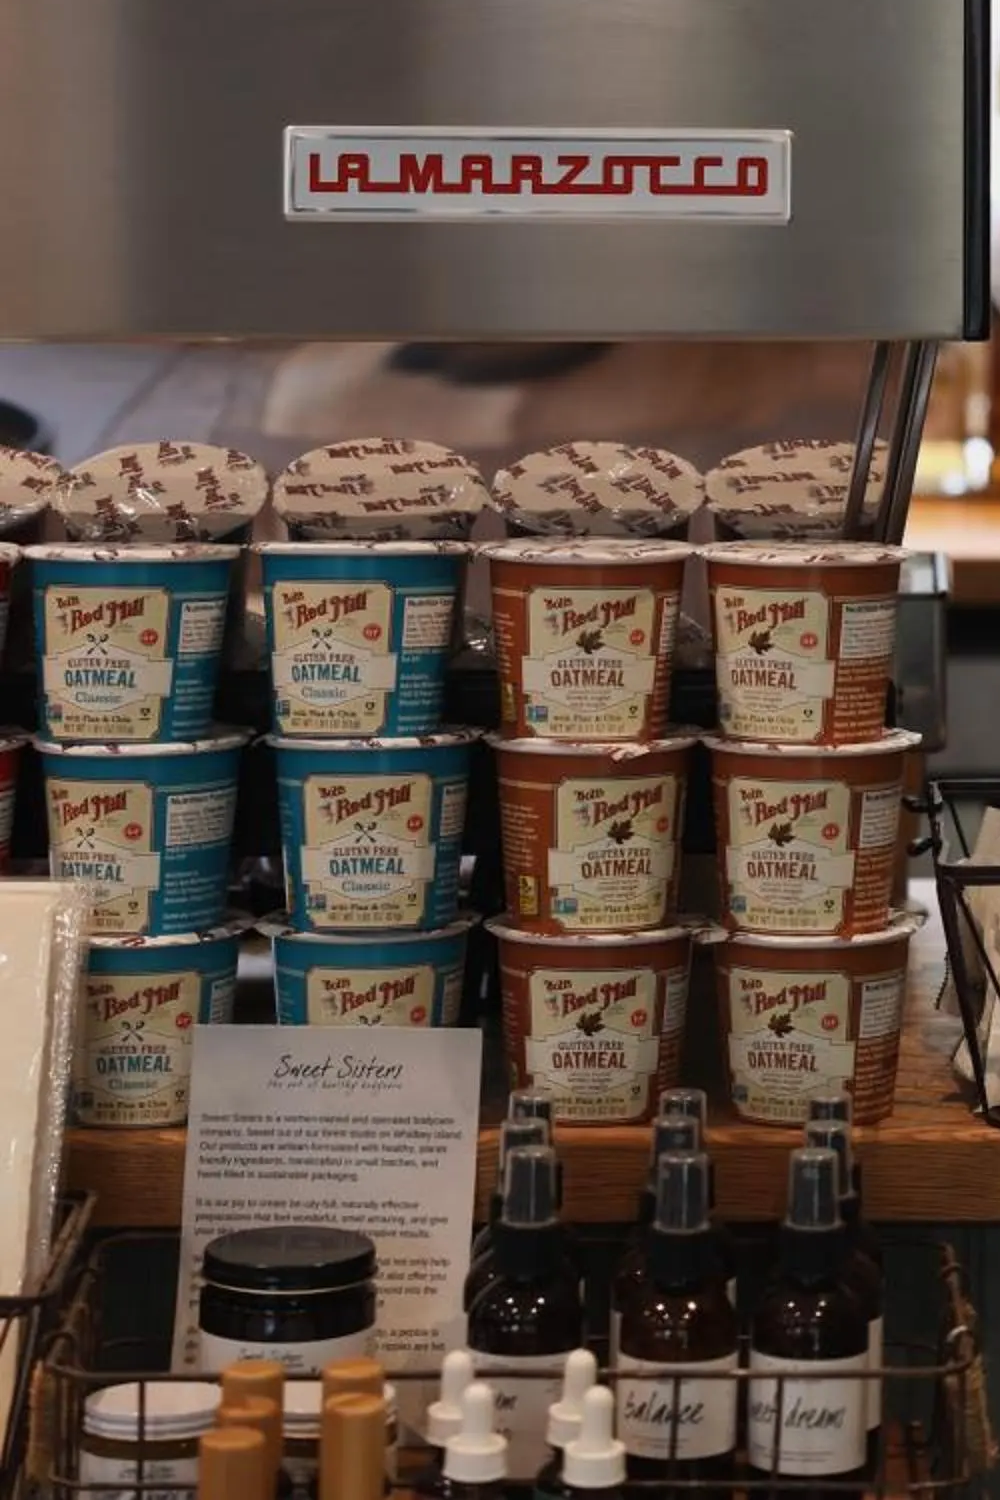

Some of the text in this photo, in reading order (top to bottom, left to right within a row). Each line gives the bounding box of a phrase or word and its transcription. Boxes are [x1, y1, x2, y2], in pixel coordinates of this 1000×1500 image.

[309, 153, 369, 192] LA
[64, 670, 137, 688] OATMEAL
[291, 664, 362, 683] OATMEAL
[551, 670, 625, 687] OATMEAL
[731, 670, 797, 690] OATMEAL
[329, 858, 405, 876] OATMEAL
[581, 860, 653, 879] OATMEAL
[746, 861, 818, 881] OATMEAL
[96, 1056, 173, 1073] OATMEAL
[274, 1054, 404, 1080] Sweet Sisters
[552, 1051, 627, 1069] OATMEAL
[748, 1051, 819, 1073] OATMEAL
